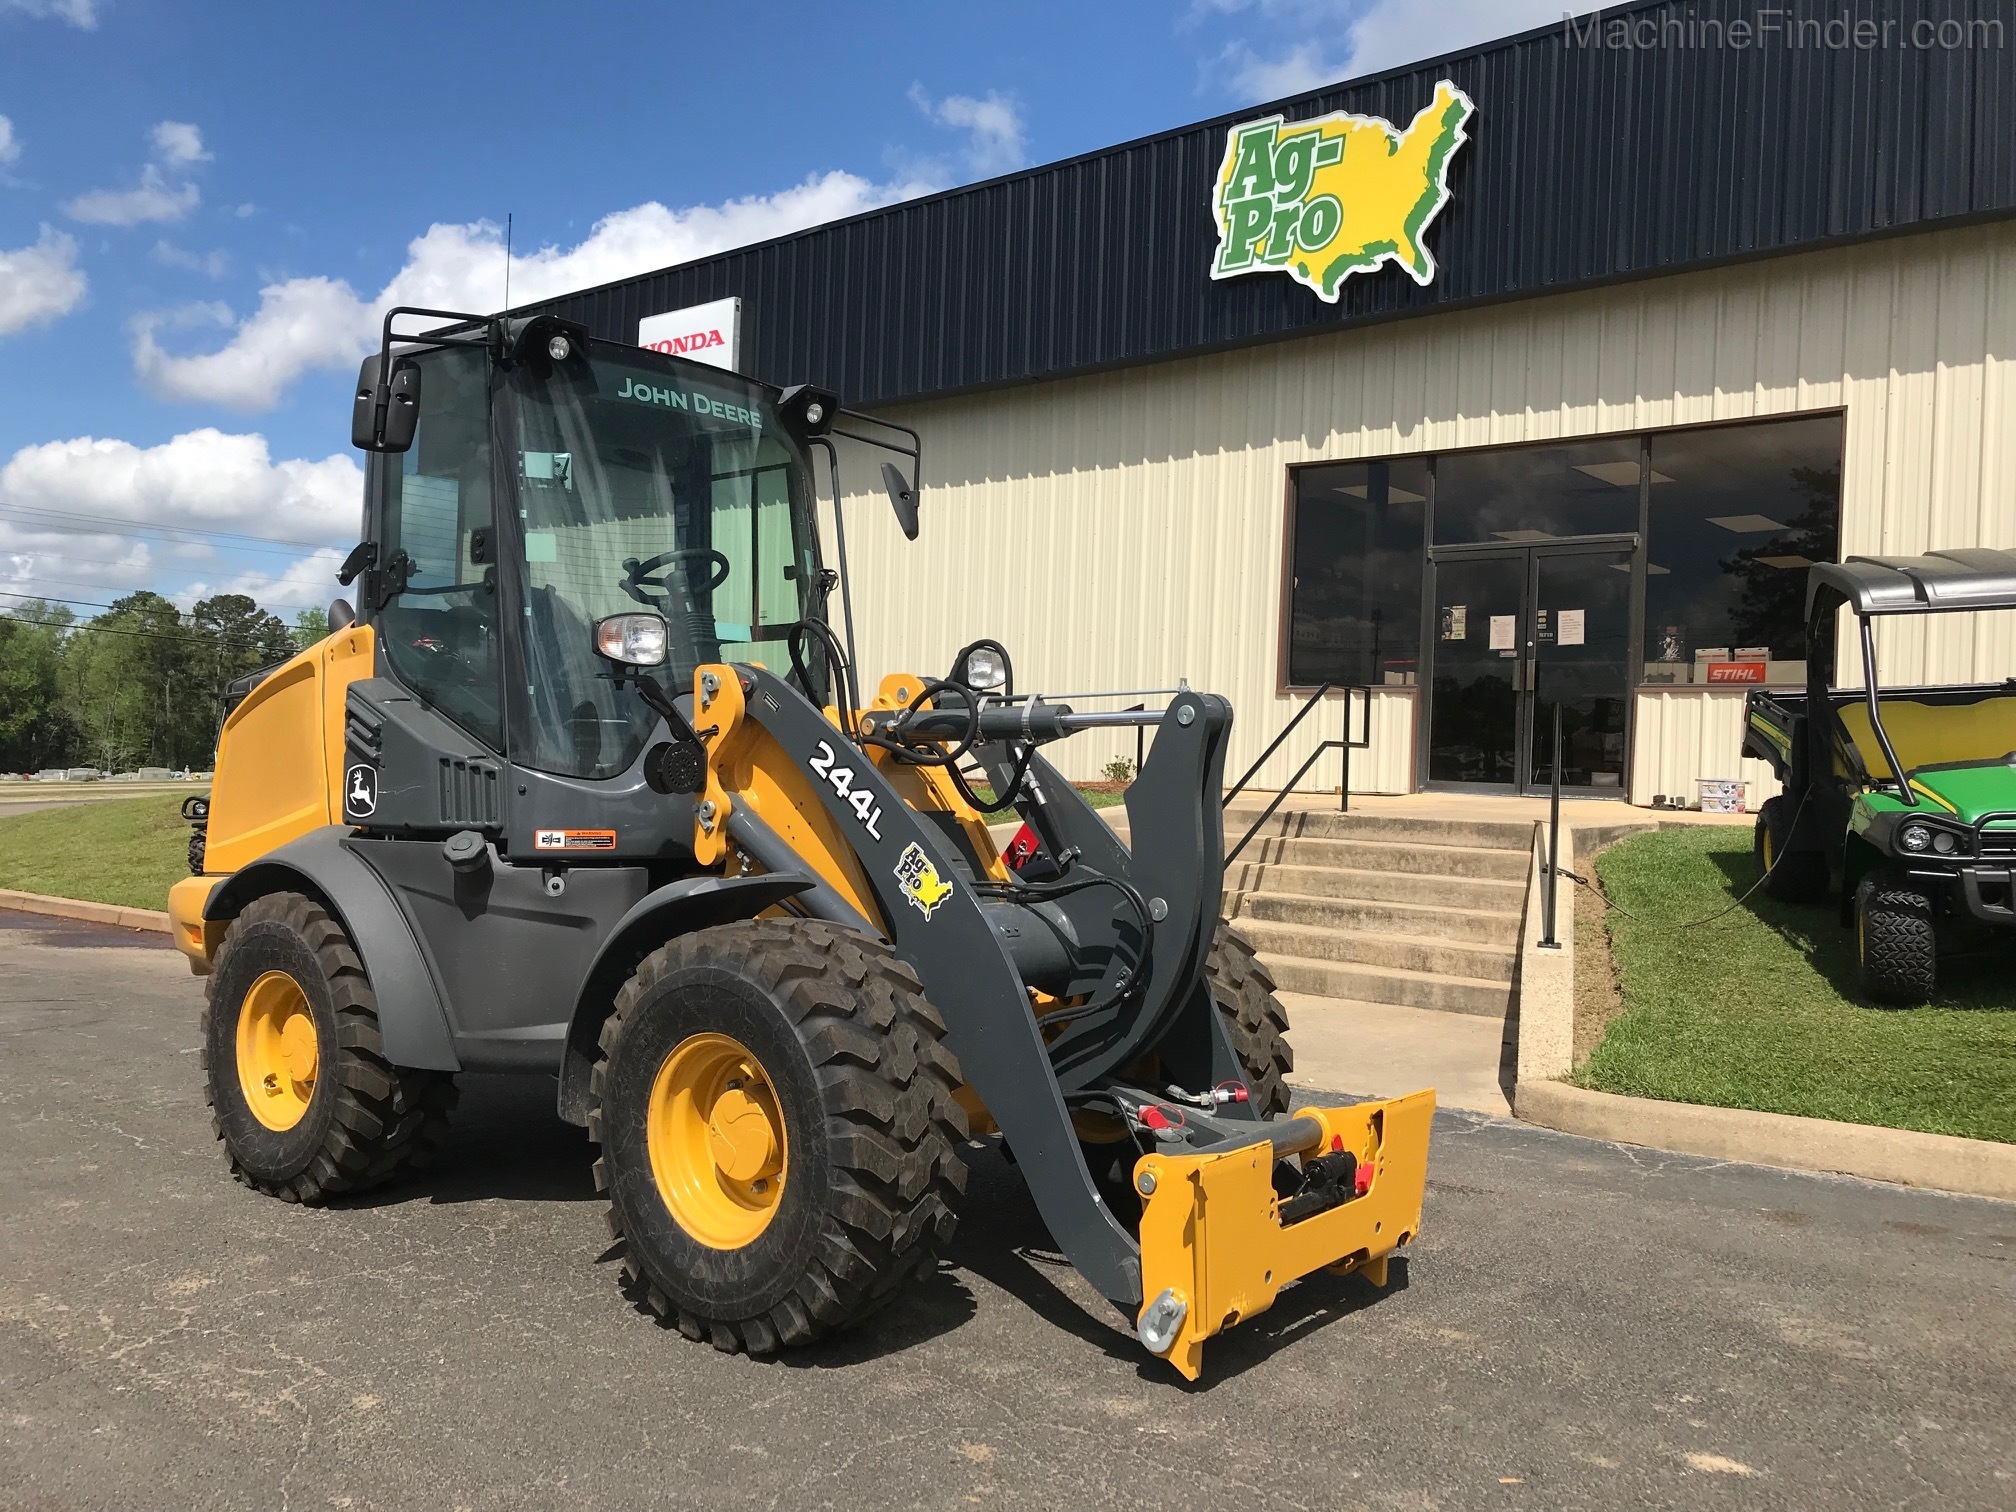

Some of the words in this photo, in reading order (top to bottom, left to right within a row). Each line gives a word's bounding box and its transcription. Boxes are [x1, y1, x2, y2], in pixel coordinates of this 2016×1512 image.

[1221, 122, 1345, 206] Ag-
[1218, 196, 1343, 271] Pro
[618, 378, 688, 410] JOHN
[693, 392, 763, 429] DEERE
[1711, 669, 1758, 680] STIHL
[808, 739, 882, 841] 244L
[898, 860, 923, 890] Pro
[905, 847, 930, 874] Ag-
